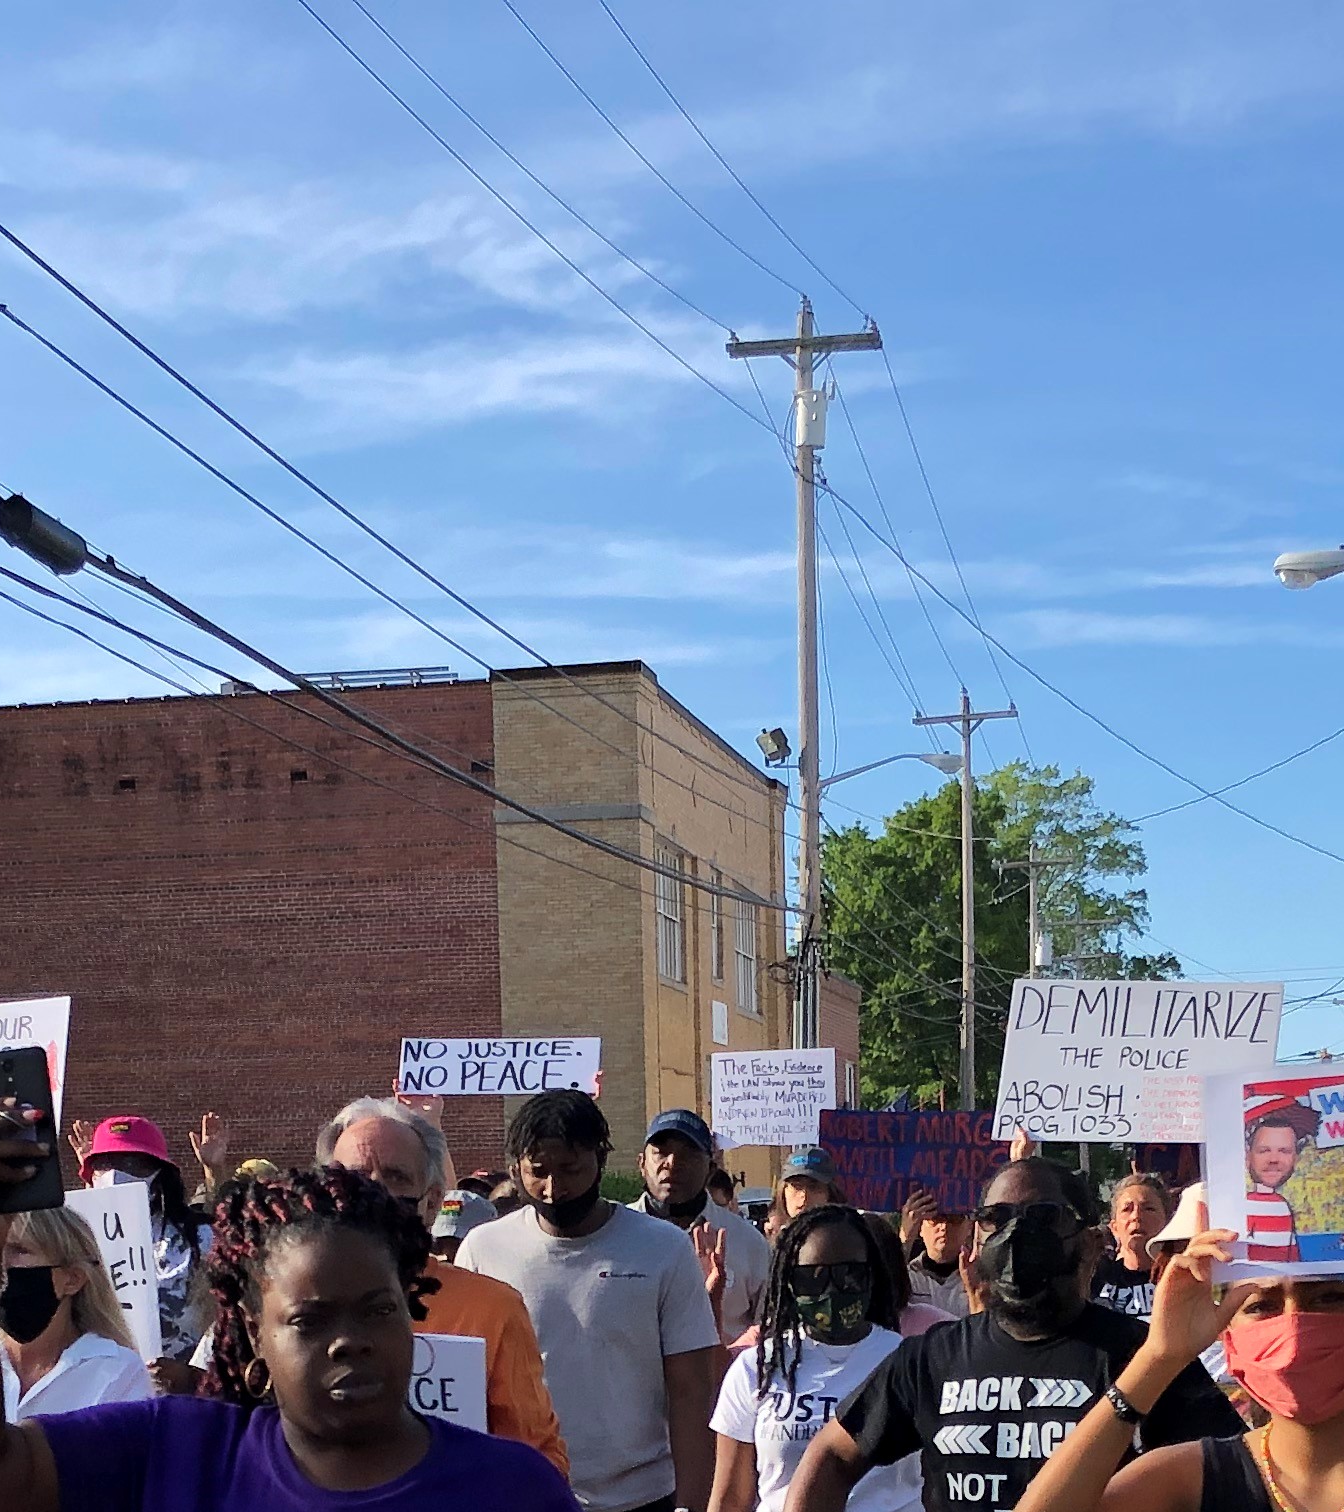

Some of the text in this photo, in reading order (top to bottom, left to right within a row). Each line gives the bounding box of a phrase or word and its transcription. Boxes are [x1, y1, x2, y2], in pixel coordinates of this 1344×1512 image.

[1015, 984, 1281, 1043] DEMILITARIZE
[404, 1040, 583, 1063] NO JUSTICE.
[718, 1058, 747, 1076] The
[1060, 1046, 1190, 1070] THE POLICE
[404, 1060, 580, 1092] NO PEACE.
[775, 1090, 827, 1104] MURDERED
[915, 1111, 994, 1147] MORG
[939, 1376, 1026, 1415] BACK
[996, 1422, 1078, 1459] BAC
[946, 1472, 1008, 1502] NOT
